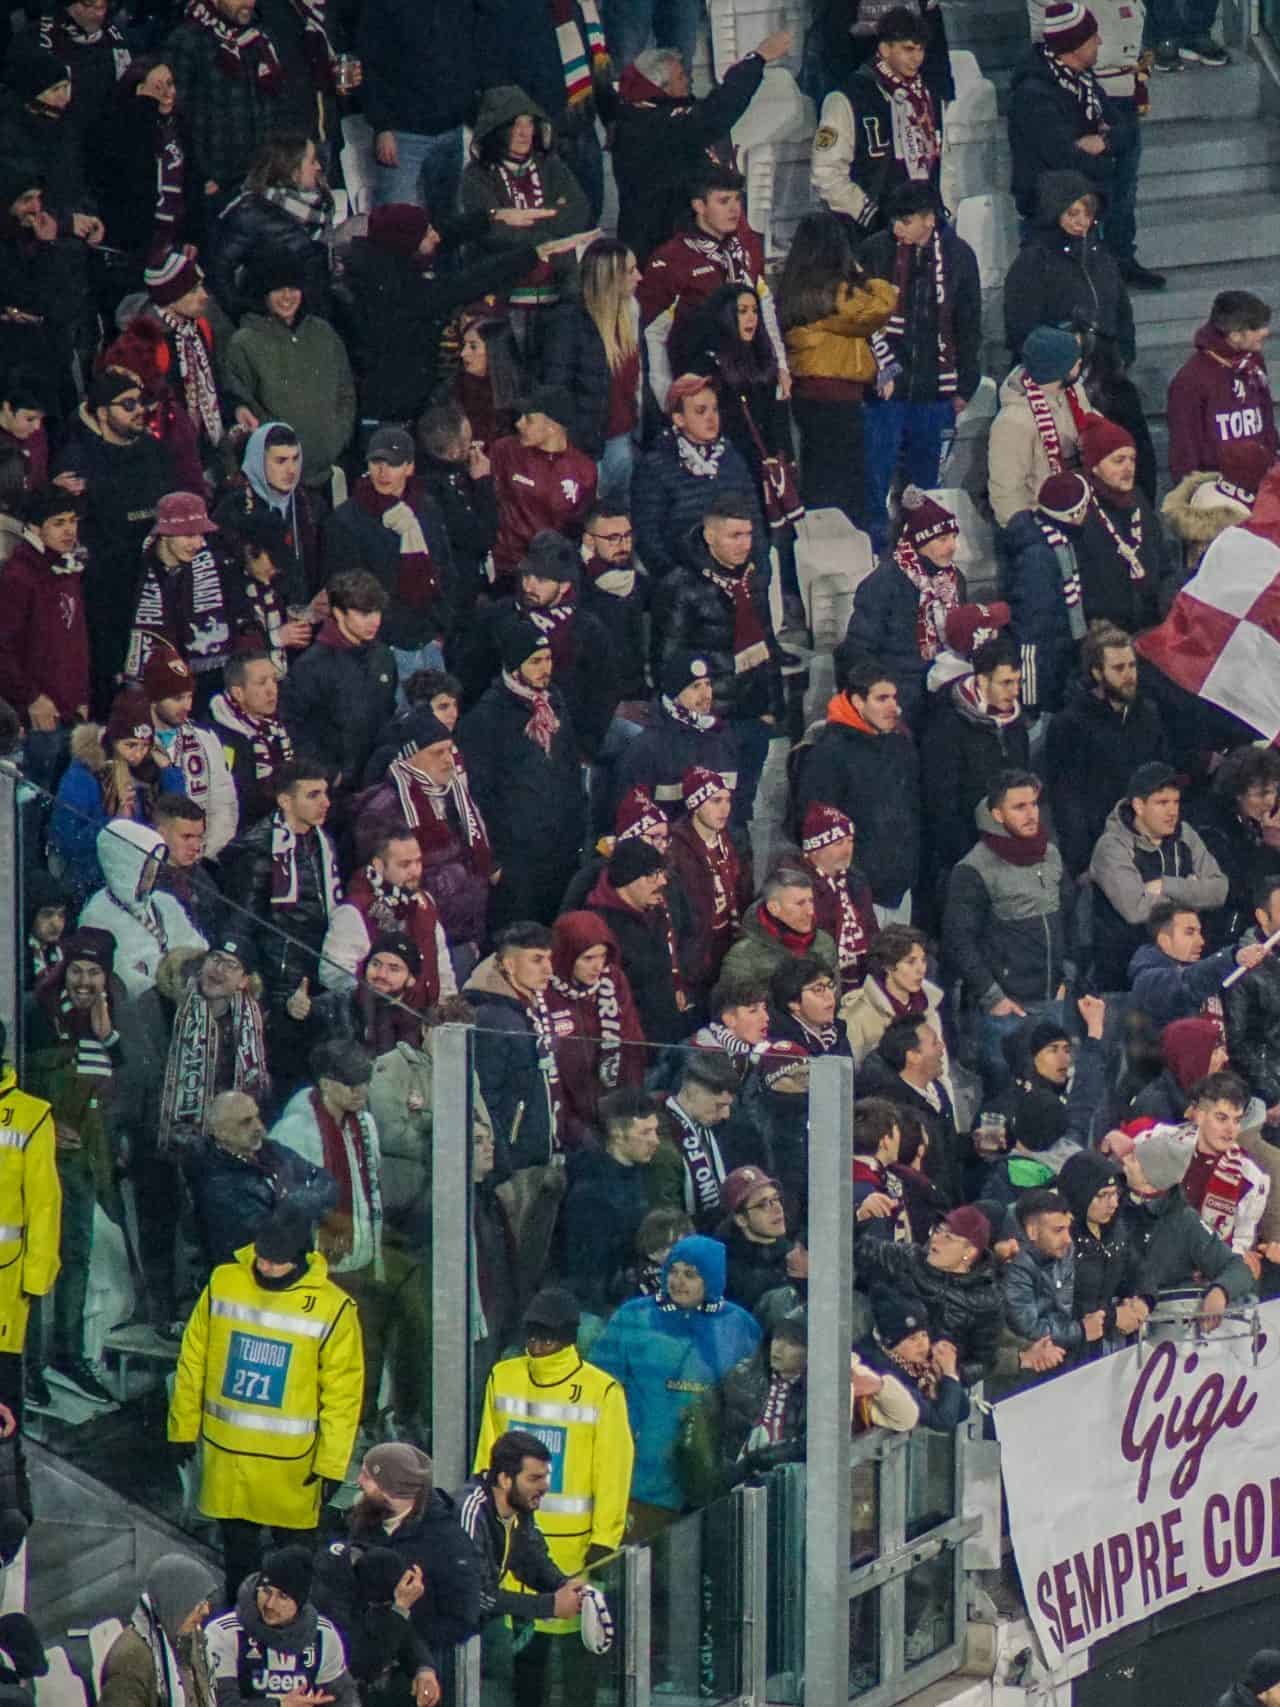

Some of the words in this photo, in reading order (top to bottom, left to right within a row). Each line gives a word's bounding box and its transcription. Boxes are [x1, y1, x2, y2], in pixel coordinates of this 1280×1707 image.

[191, 551, 223, 613] GRANATA
[231, 1369, 271, 1401] 271
[1120, 1332, 1268, 1504] Gigi
[1036, 1508, 1188, 1654] SEMPRE
